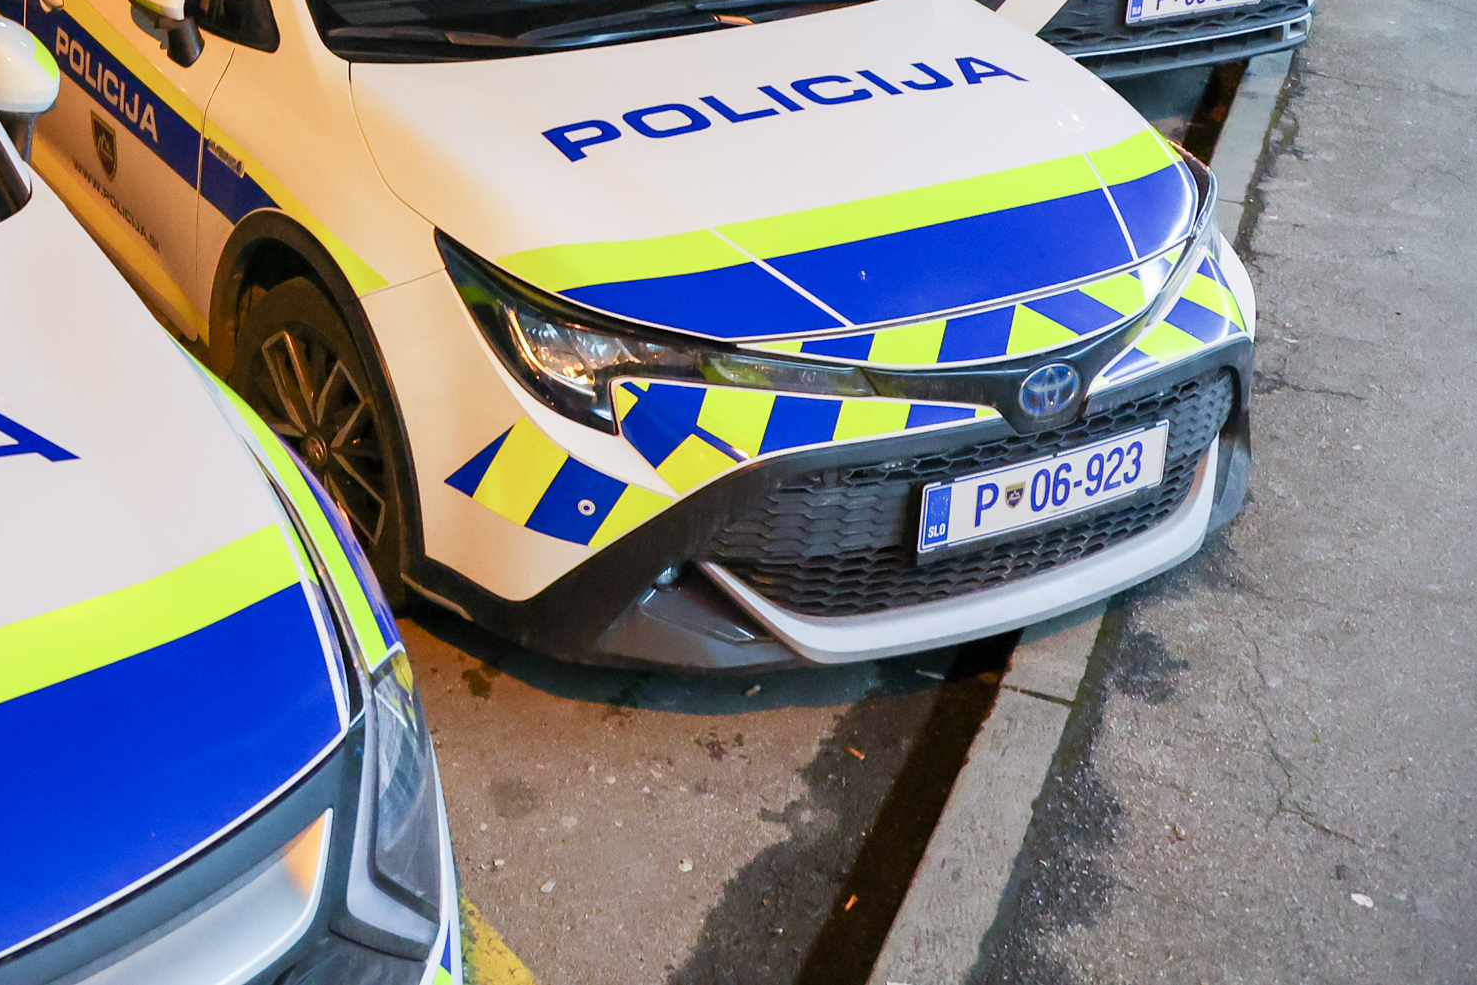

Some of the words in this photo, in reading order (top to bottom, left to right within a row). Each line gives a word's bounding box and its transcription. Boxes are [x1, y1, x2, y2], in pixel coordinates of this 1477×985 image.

[55, 26, 158, 143] POLICIJA
[541, 57, 1029, 162] POLICIJA
[927, 523, 946, 539] SLO
[974, 483, 999, 527] P
[1030, 440, 1143, 512] 06-923
